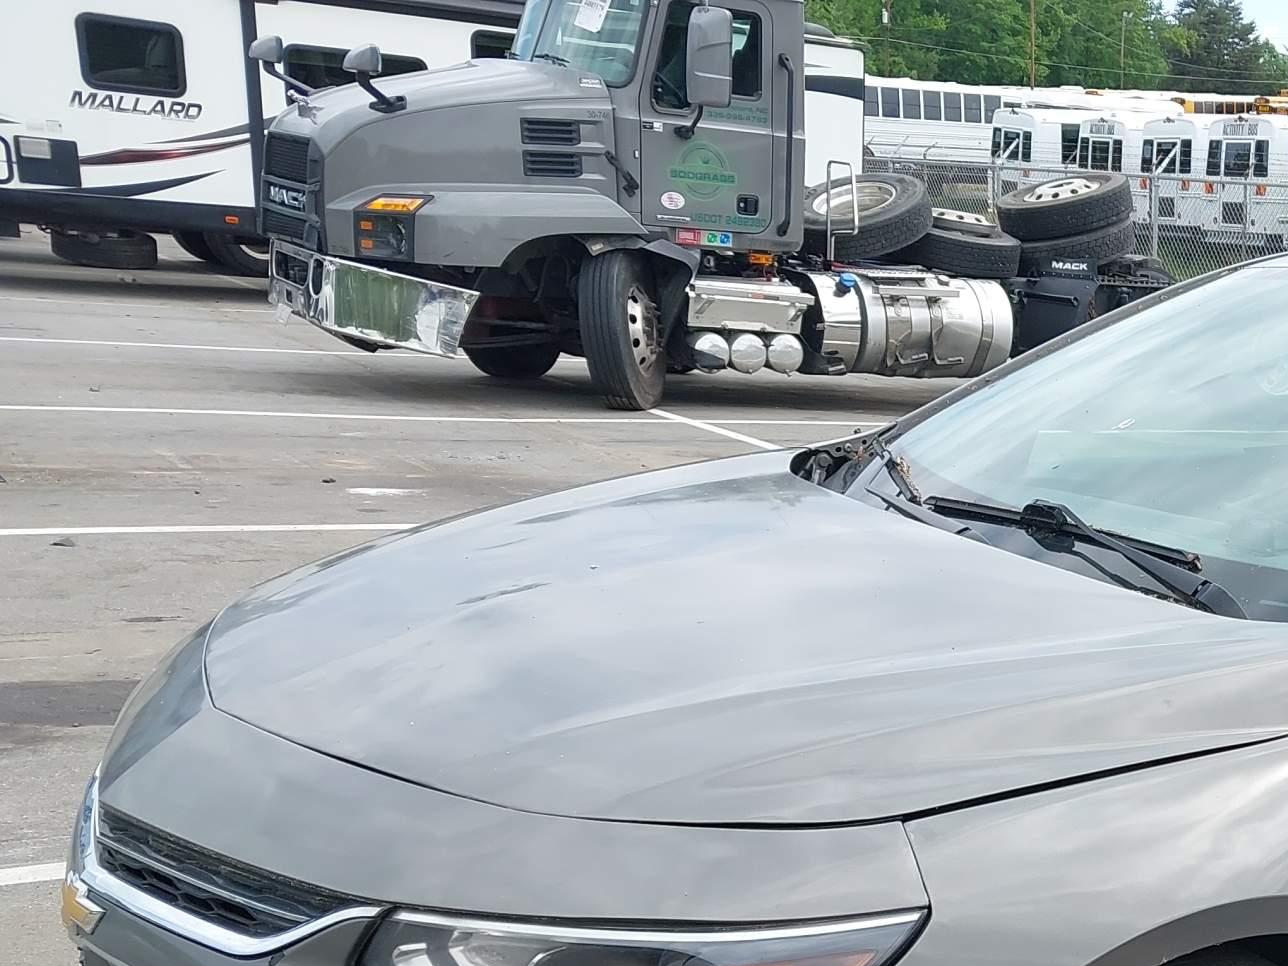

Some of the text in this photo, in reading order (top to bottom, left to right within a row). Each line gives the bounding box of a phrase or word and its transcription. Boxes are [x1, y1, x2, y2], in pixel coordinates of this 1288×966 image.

[69, 90, 203, 120] MALLARD
[1222, 123, 1259, 136] ACTIVITY BUS
[1051, 260, 1089, 271] MACK
